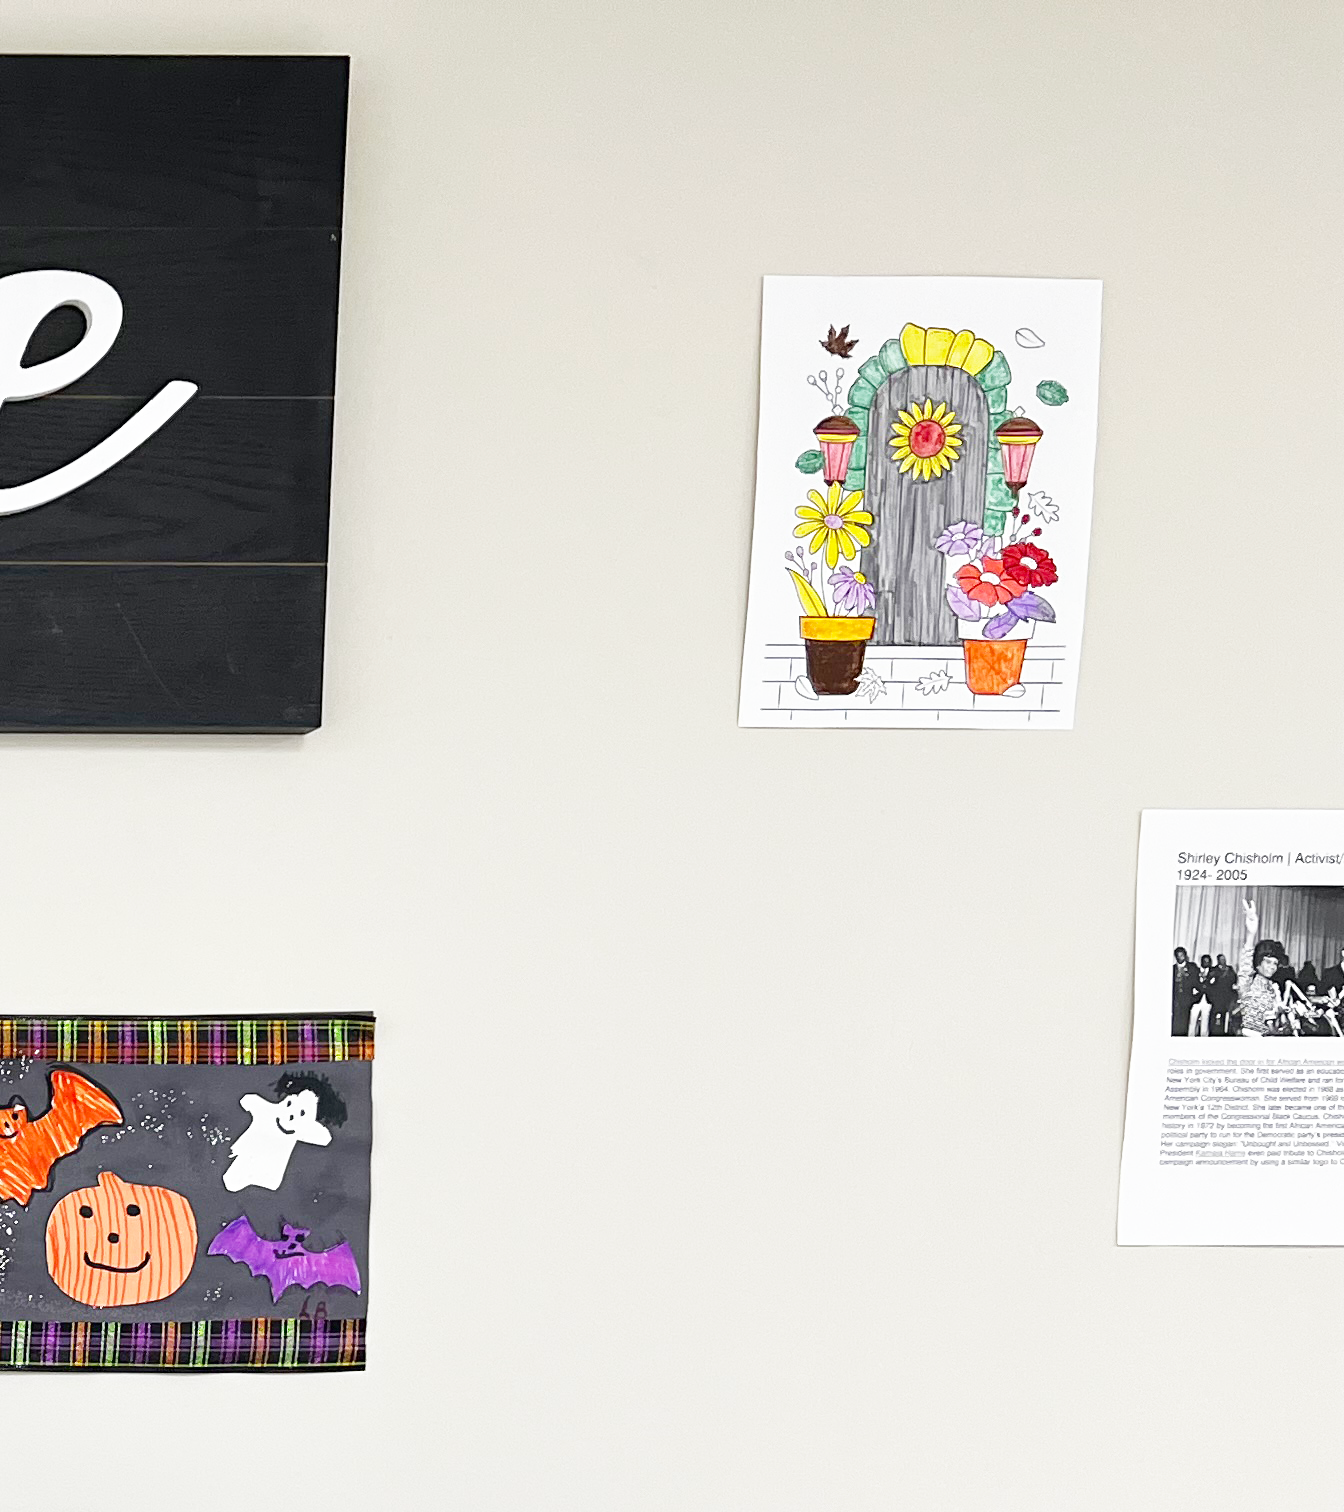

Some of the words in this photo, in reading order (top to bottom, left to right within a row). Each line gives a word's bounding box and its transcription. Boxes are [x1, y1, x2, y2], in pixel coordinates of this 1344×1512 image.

[1177, 852, 1221, 866] Shirley
[1224, 853, 1284, 864] Chisholm
[1177, 870, 1212, 880] 1924-
[1216, 870, 1248, 880] 2005
